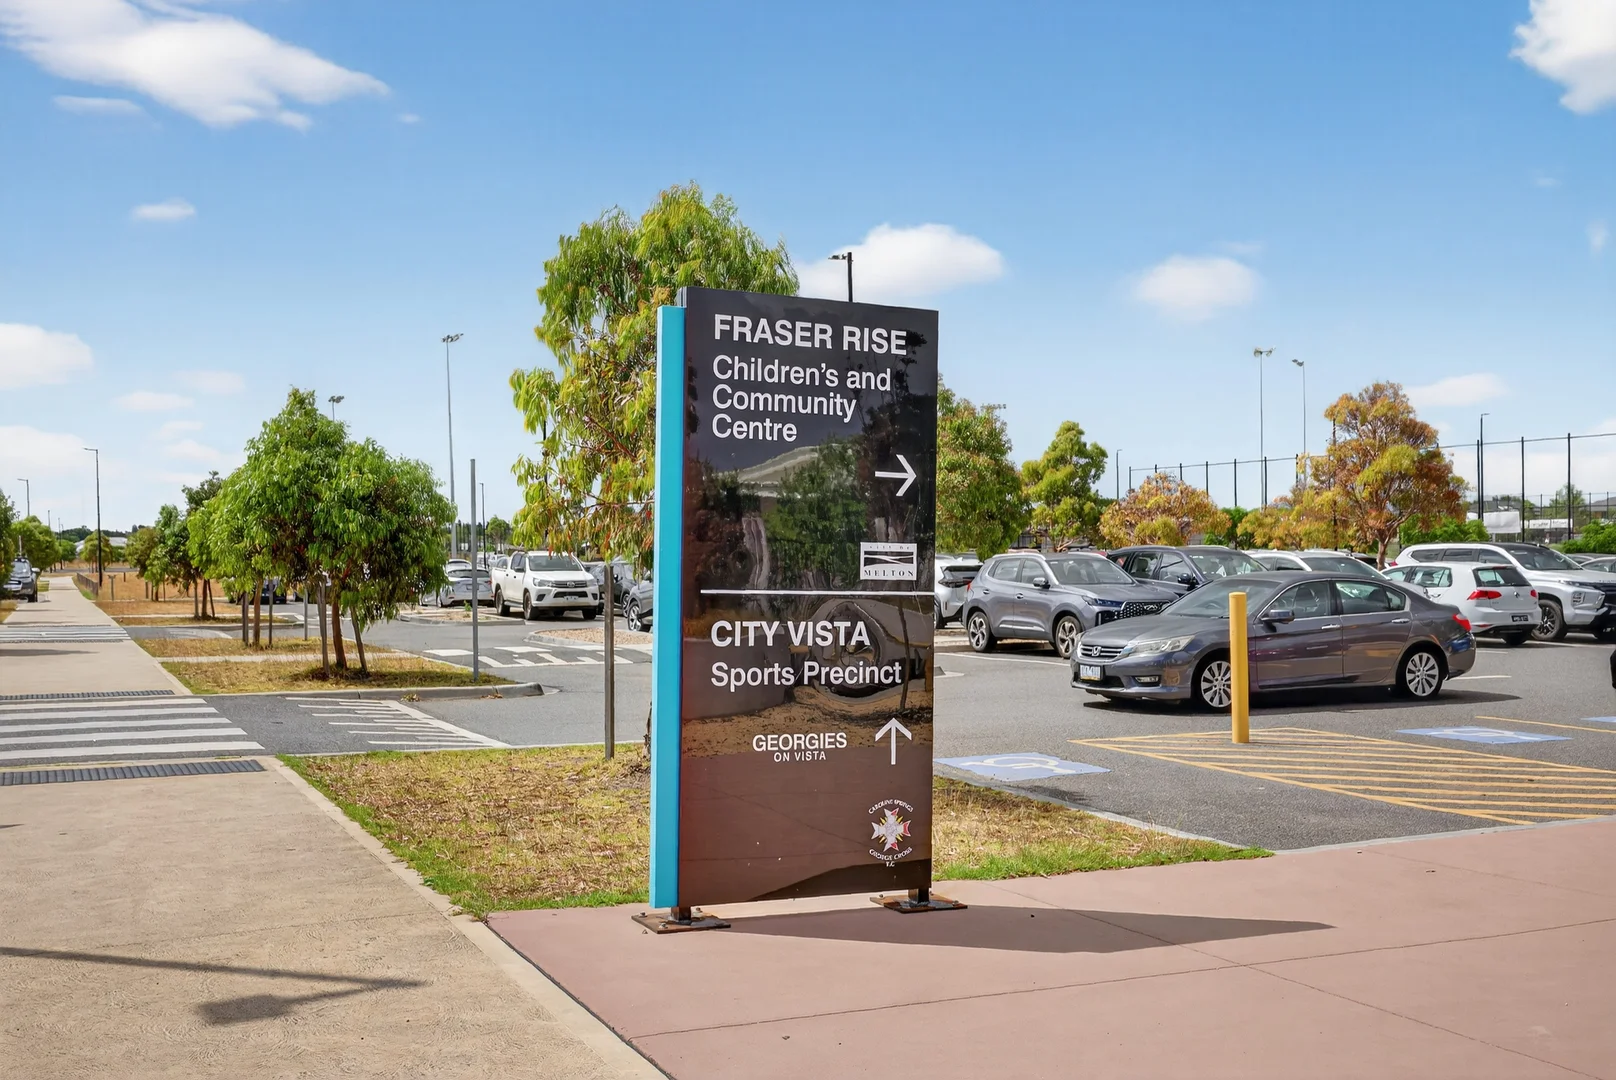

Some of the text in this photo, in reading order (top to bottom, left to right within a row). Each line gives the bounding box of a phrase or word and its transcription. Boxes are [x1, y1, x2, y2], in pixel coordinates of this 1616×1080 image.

[714, 313, 907, 356] FRASER RISE
[712, 354, 891, 391] Children's and
[712, 384, 857, 423] Community
[712, 413, 798, 442] Centre
[863, 569, 914, 577] MELTON
[710, 620, 871, 648] CITY VISTA
[711, 661, 902, 692] Sports Precinct
[752, 732, 848, 752] GEORGIES
[773, 751, 827, 762] ON VISTA
